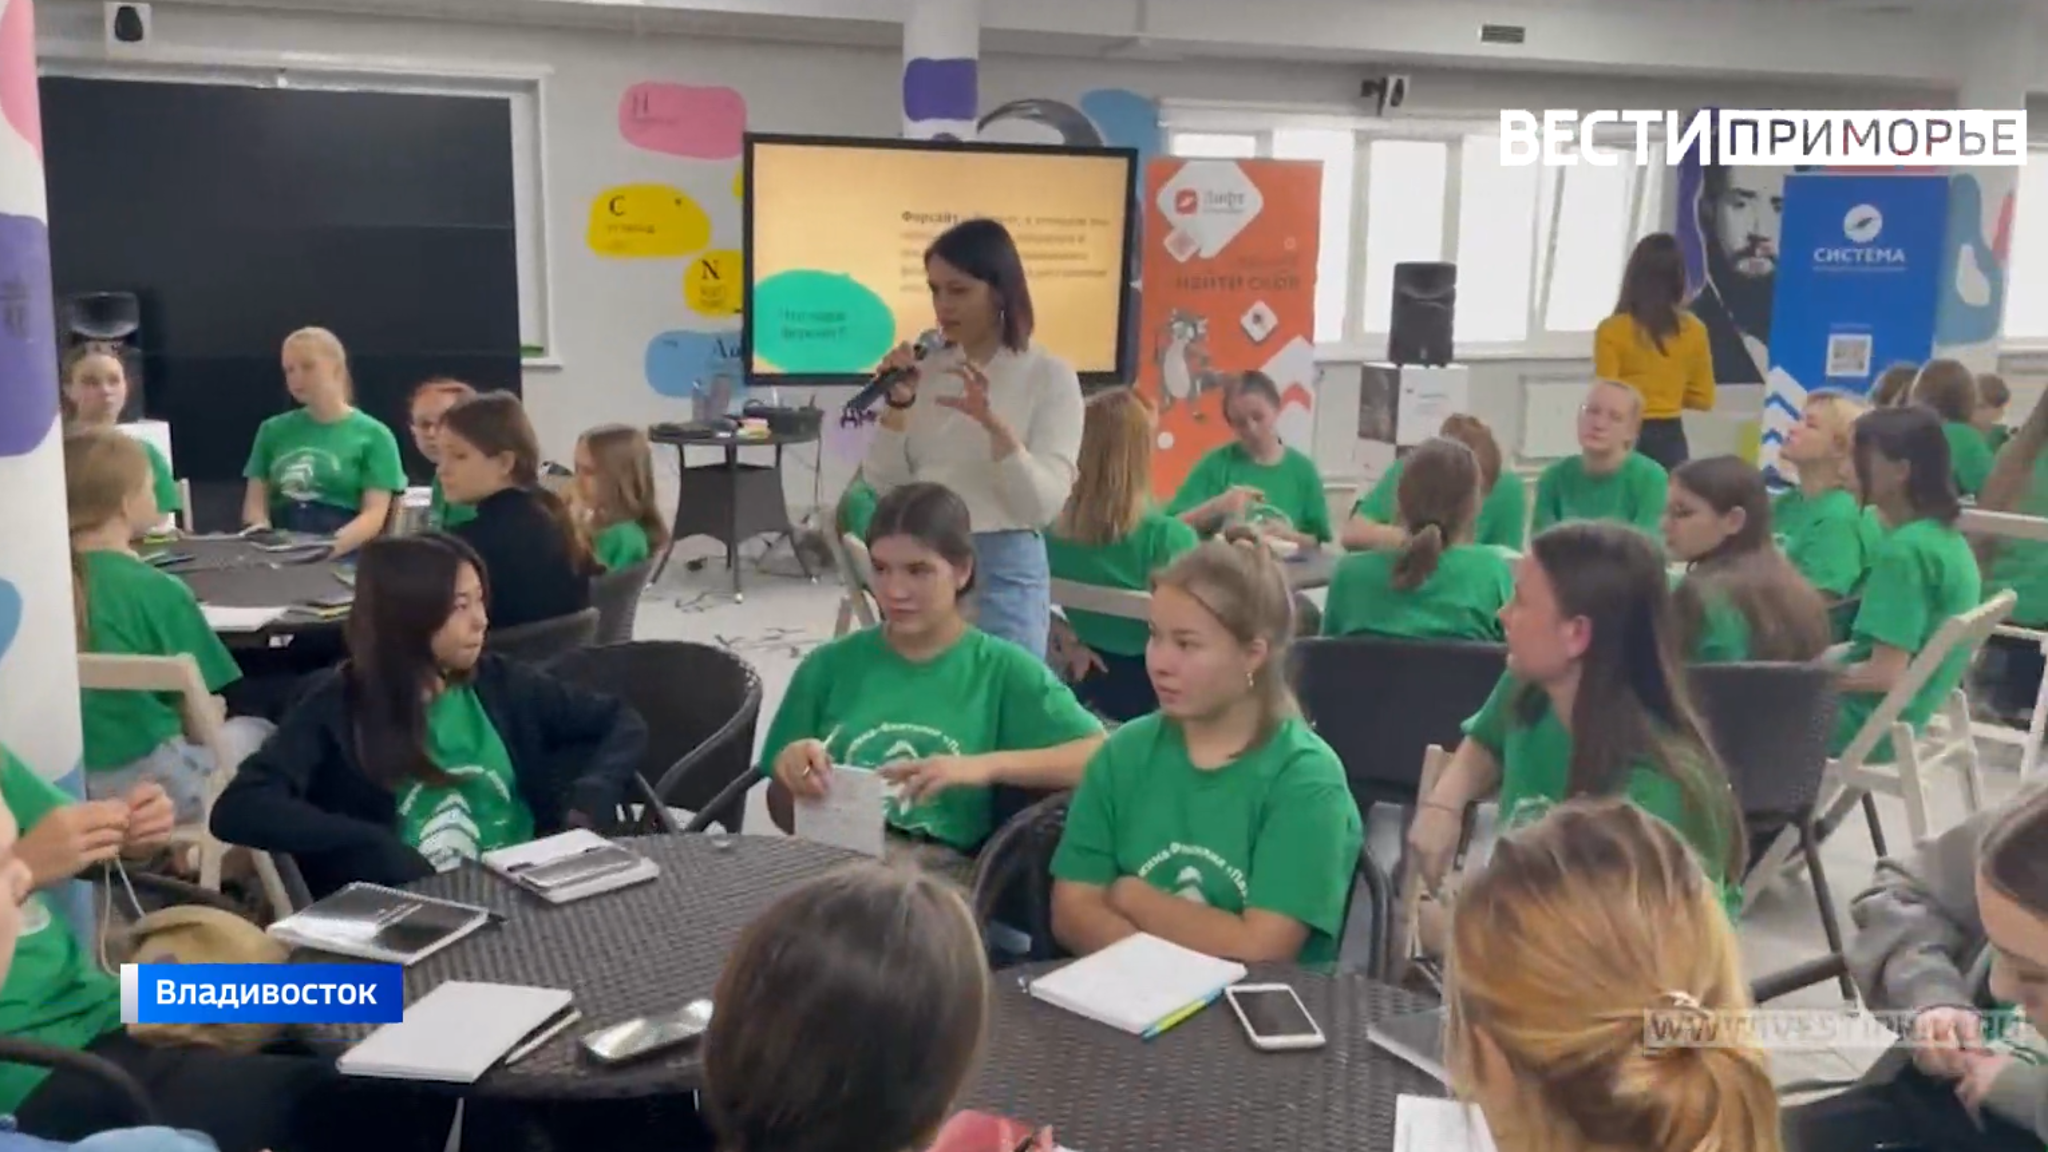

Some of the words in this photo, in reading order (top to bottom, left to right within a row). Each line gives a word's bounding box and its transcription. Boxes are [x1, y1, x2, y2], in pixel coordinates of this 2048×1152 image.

[609, 195, 626, 217] C
[1813, 248, 1906, 263] СИСТЕМА
[701, 259, 720, 280] N
